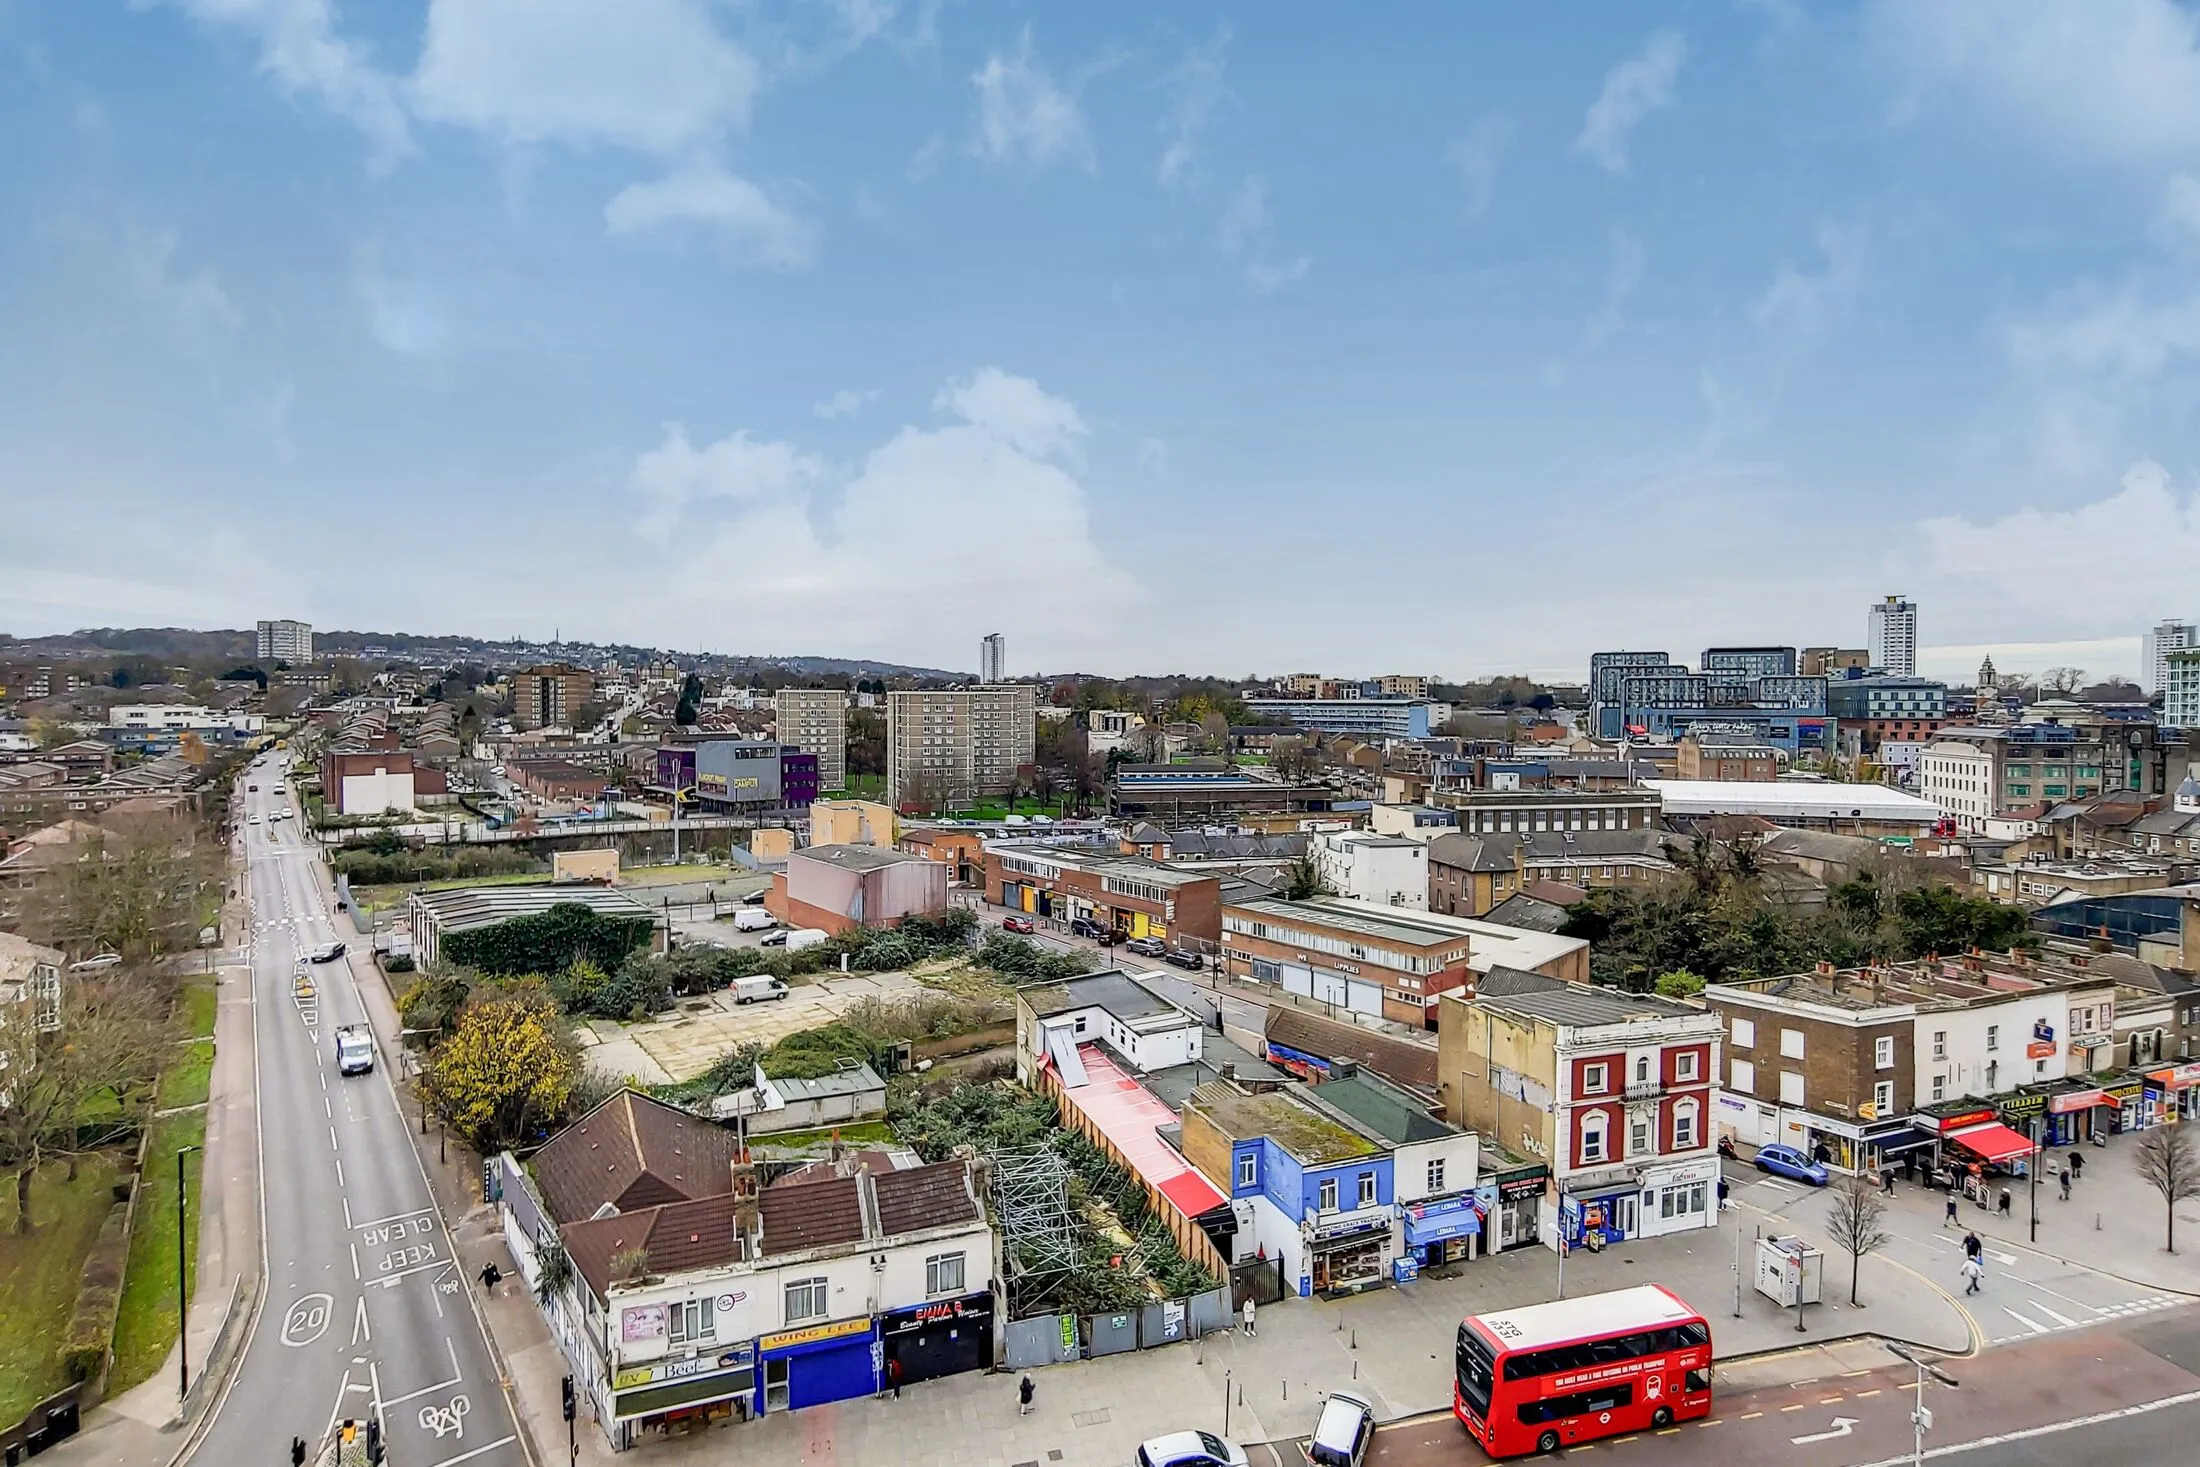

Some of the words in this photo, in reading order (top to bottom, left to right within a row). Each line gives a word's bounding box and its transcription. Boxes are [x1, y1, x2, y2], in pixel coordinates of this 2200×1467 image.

[363, 1217, 433, 1246] CLEAR
[379, 1242, 436, 1271] KEEP
[289, 1307, 324, 1334] 20
[1501, 1321, 1523, 1336] STG
[773, 1330, 819, 1343] WING
[827, 1323, 856, 1334] LEE
[665, 1360, 700, 1378] Beef
